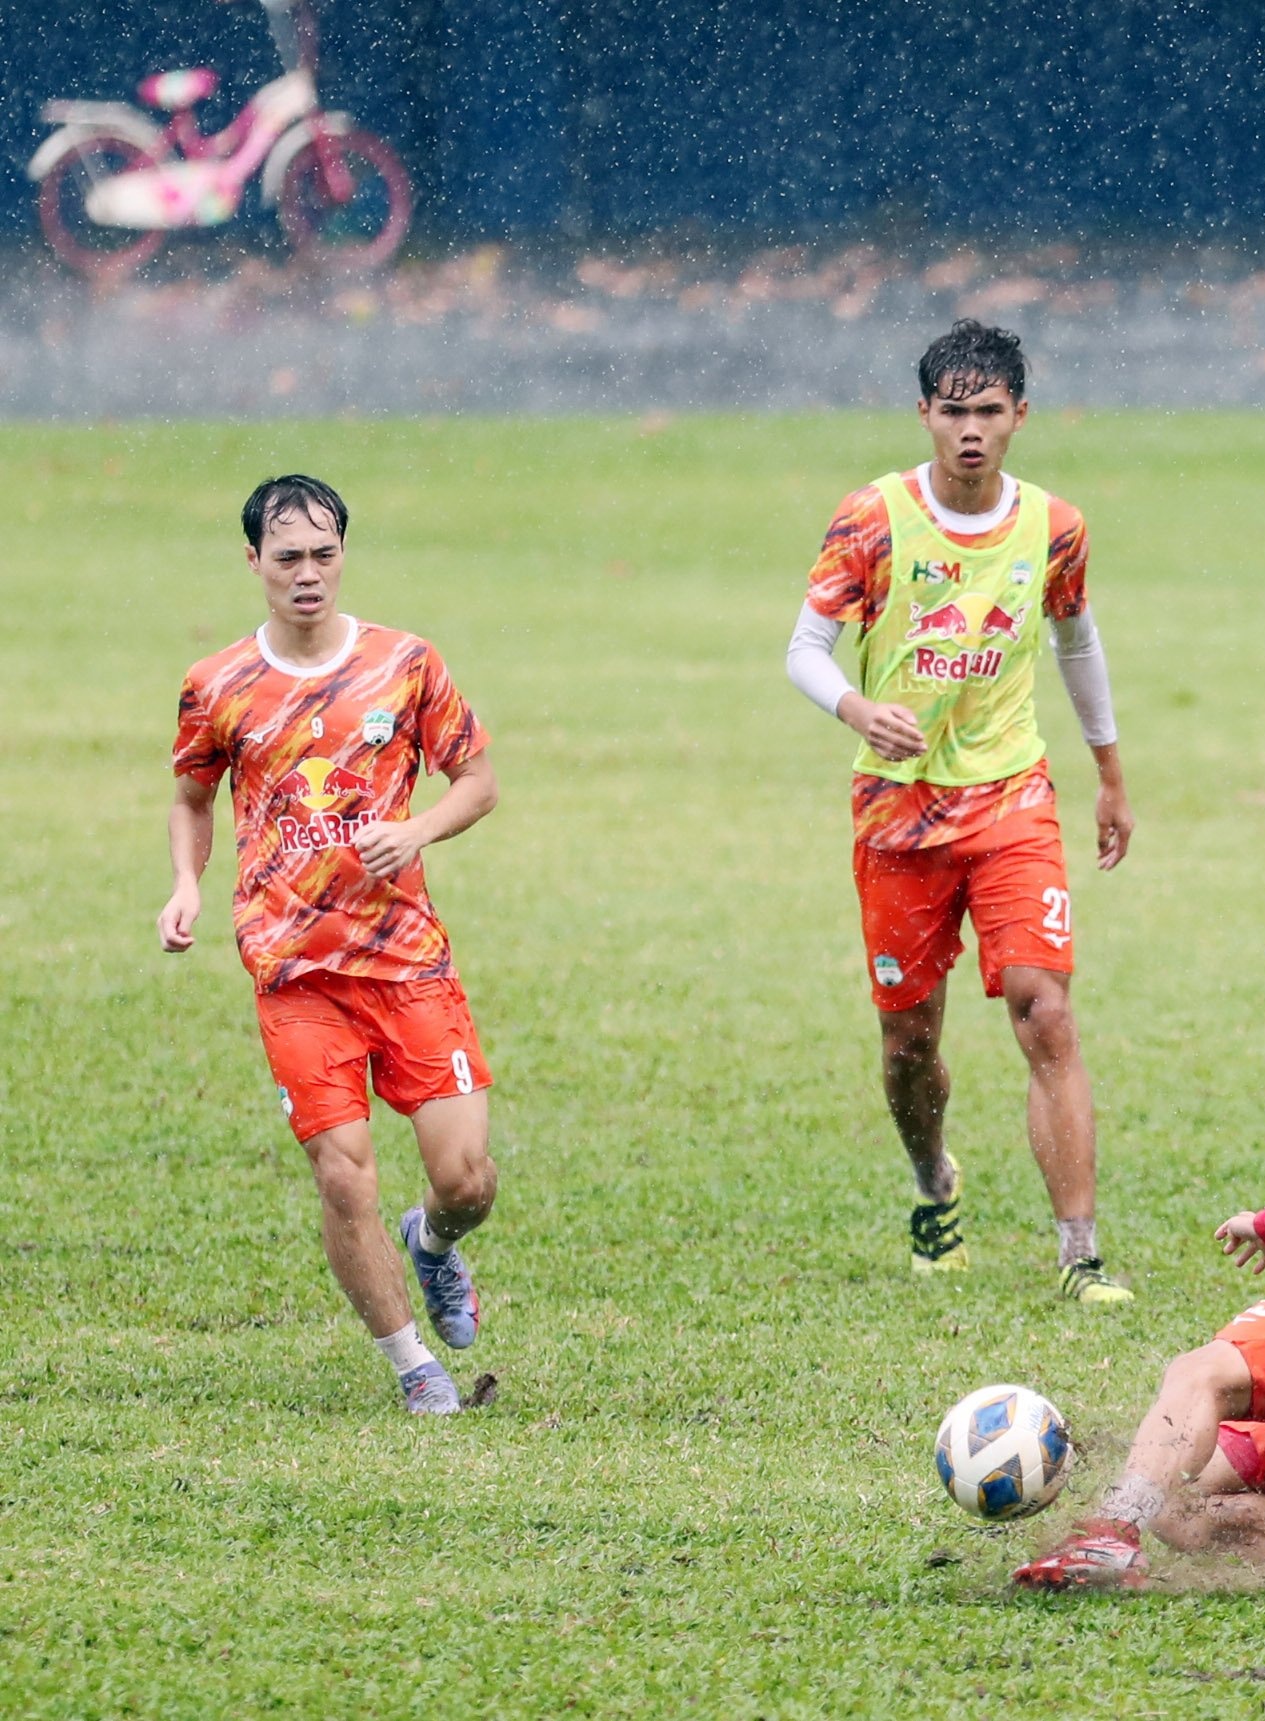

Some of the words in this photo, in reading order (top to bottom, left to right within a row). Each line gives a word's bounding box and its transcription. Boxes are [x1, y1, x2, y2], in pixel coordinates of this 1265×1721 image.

[911, 559, 961, 584] HSM
[310, 716, 325, 739] 9
[451, 1049, 474, 1095] 9
